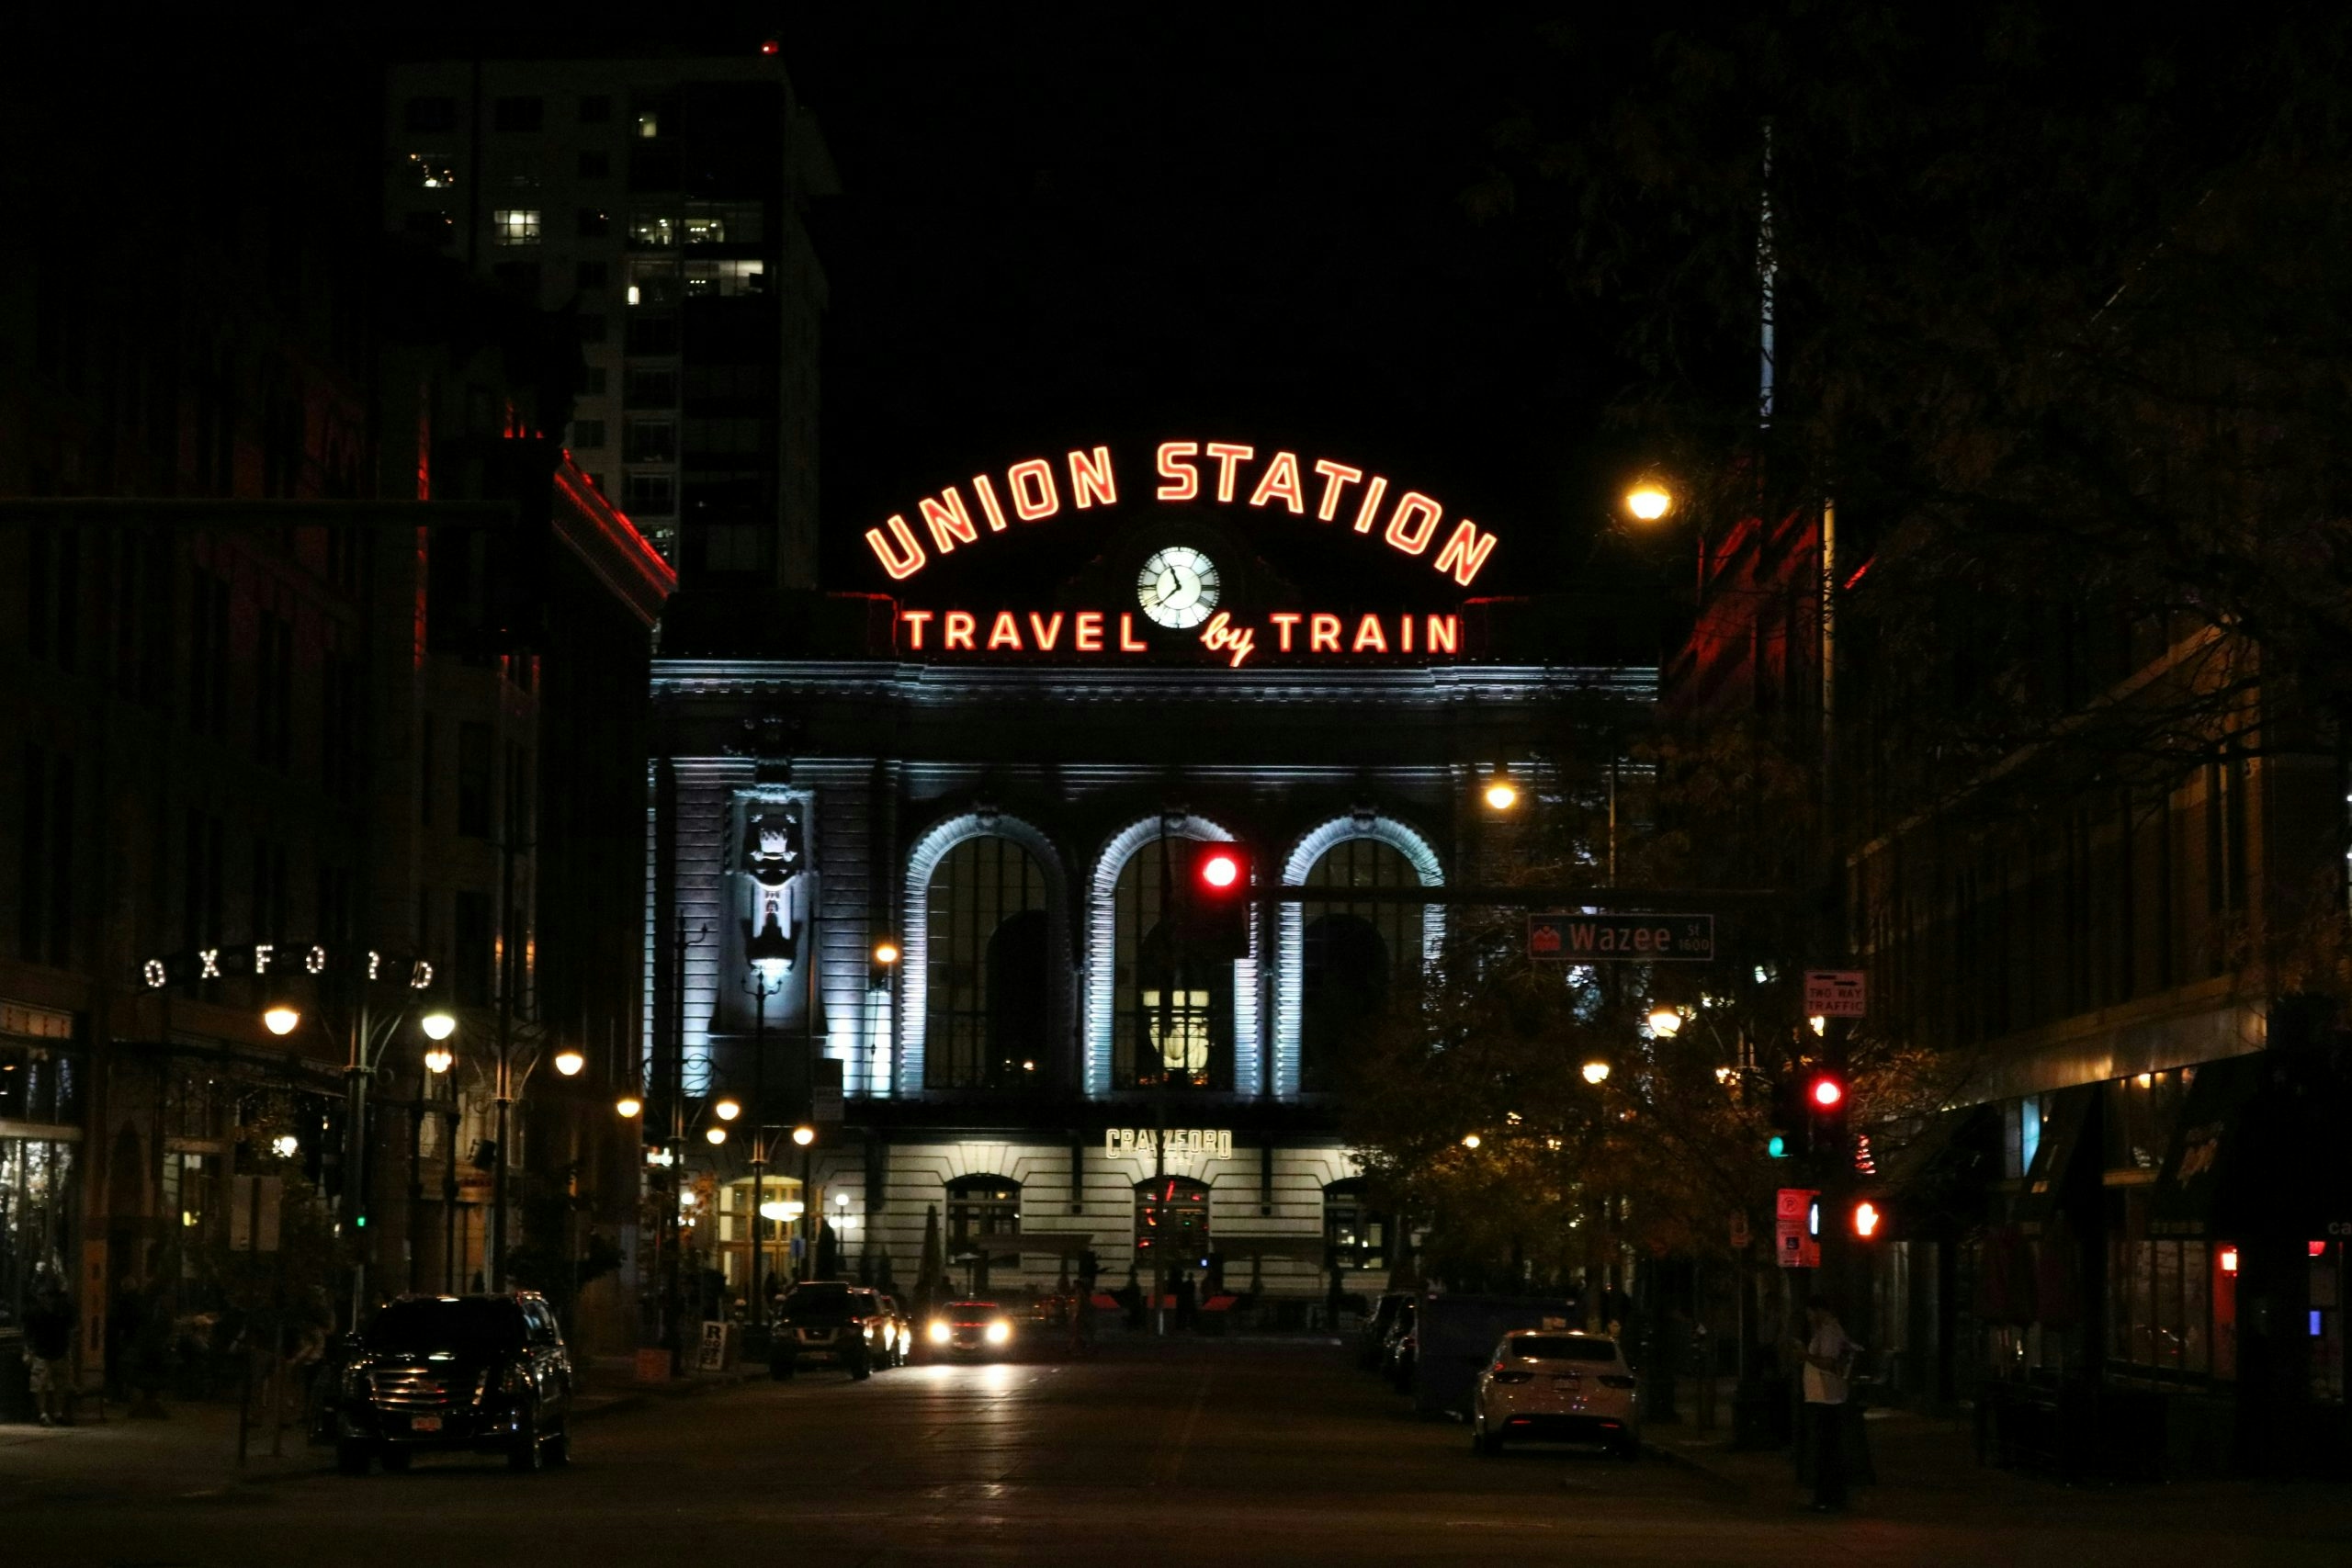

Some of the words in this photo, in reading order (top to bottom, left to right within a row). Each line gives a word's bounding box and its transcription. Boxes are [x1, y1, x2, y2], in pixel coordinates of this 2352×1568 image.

[865, 446, 1117, 580] UNION
[1157, 442, 1498, 587] STATION
[901, 611, 1148, 651] TRAVEL
[1200, 611, 1255, 667] by
[1270, 613, 1457, 653] TRAIN
[1570, 923, 1671, 952] Wazee
[1808, 1000, 1862, 1010] TRAFFIC
[1809, 988, 1832, 998] TWO
[1838, 988, 1861, 998] WAY
